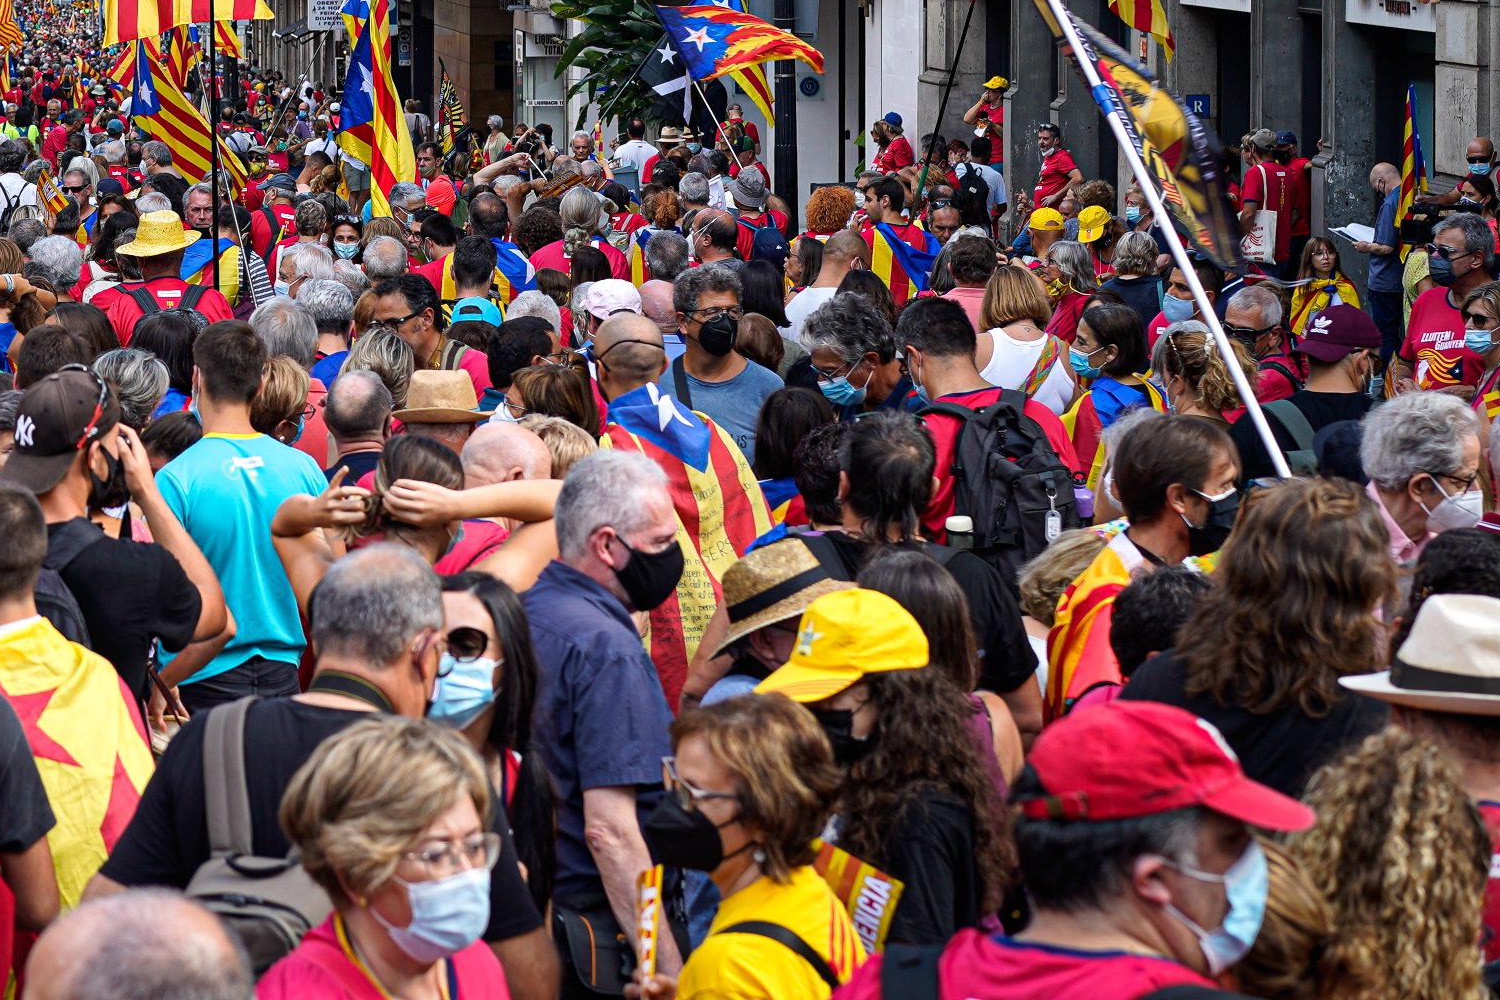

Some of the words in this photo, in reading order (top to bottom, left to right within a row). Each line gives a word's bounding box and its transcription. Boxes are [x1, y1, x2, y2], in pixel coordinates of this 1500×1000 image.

[1193, 100, 1204, 113] R
[1310, 327, 1329, 335] adidas
[1420, 331, 1452, 343] LLUITEM
[1434, 339, 1466, 351] GUANYEM
[15, 413, 36, 447] NY
